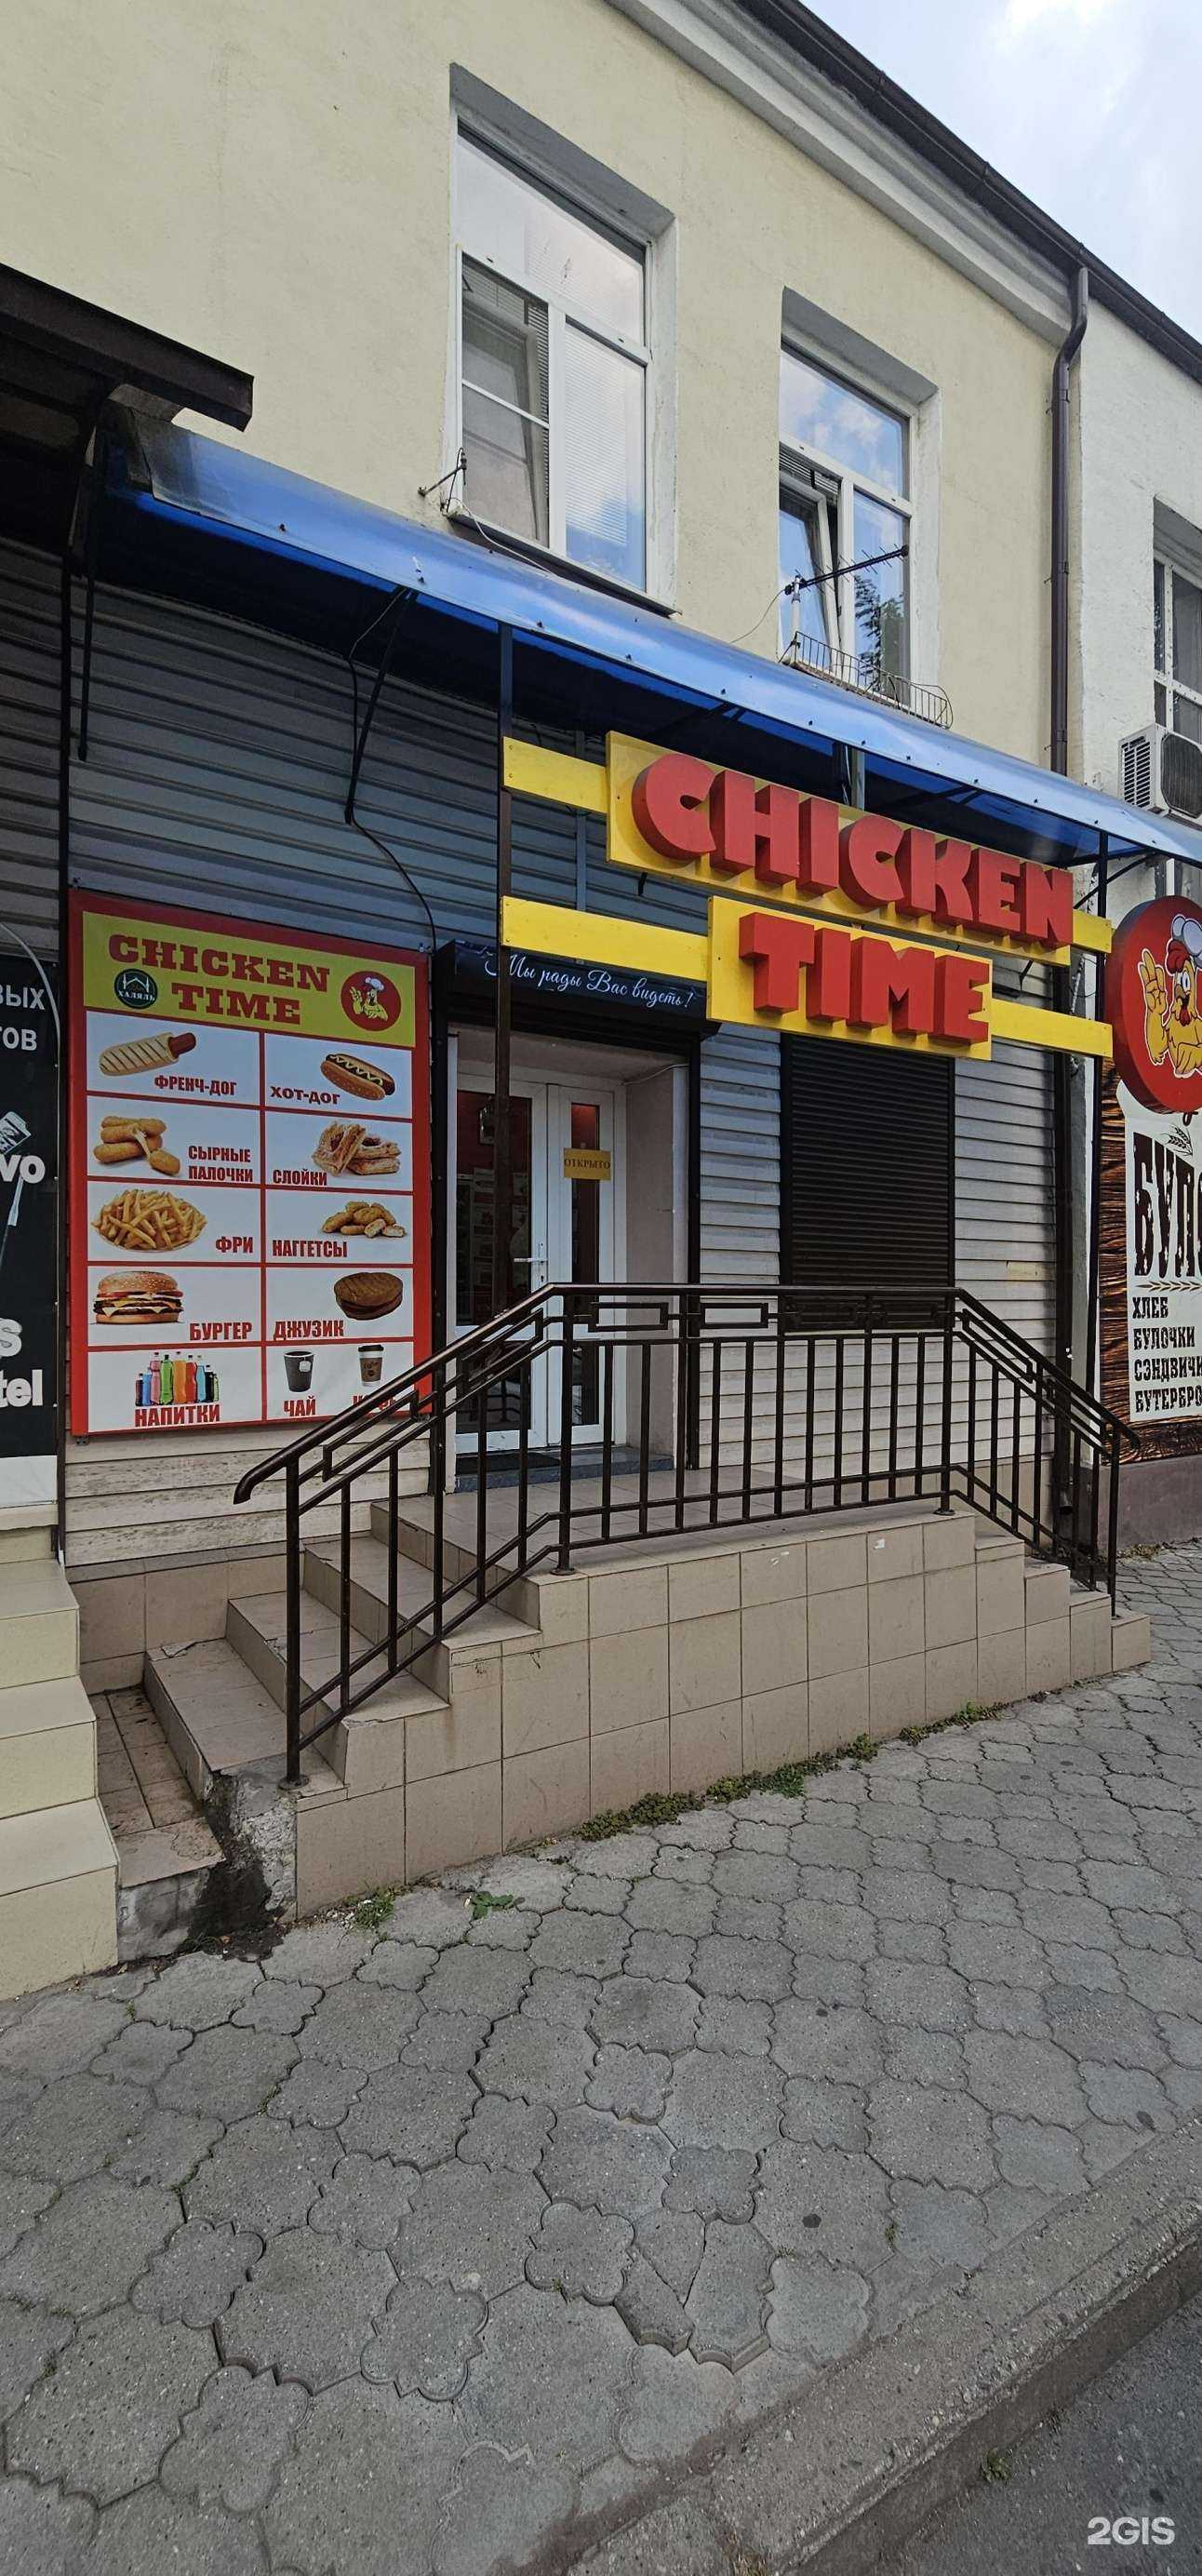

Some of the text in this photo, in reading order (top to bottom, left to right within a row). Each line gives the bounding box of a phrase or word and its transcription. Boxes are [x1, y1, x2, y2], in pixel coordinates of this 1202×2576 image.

[632, 753, 1073, 949] CHICKEN
[109, 934, 329, 992] CHICKEN
[539, 970, 581, 992] рады
[586, 969, 628, 996] Вас
[739, 912, 989, 1045] TIME
[118, 989, 155, 1001] ХАЛЯЛЬ
[172, 983, 300, 1025] TIME
[0, 1026, 37, 1051] ОВ
[154, 1074, 237, 1096] ФРЕНЧ-ДОГ
[271, 1085, 341, 1106] ХОТ-ДОГ
[188, 1145, 251, 1163] СЫРНЫЕ
[564, 1158, 610, 1169] ОТКРЫТО
[188, 1165, 254, 1183] ПАЛОЧКИ
[273, 1168, 327, 1186] СЛОЙКИ
[1133, 1132, 1202, 1279] БУЛ
[215, 1236, 254, 1254] ФРИ
[272, 1239, 348, 1258] НАГГЕТСЫ
[1132, 1296, 1169, 1320] ХЛЕБ
[190, 1322, 252, 1341] БУРГЕР
[273, 1320, 344, 1341] ДЖУЗИК
[1133, 1326, 1195, 1350] БУЛОЧКИ
[134, 1404, 220, 1428] НАПИТКИ
[283, 1398, 316, 1417] ЧАЙ
